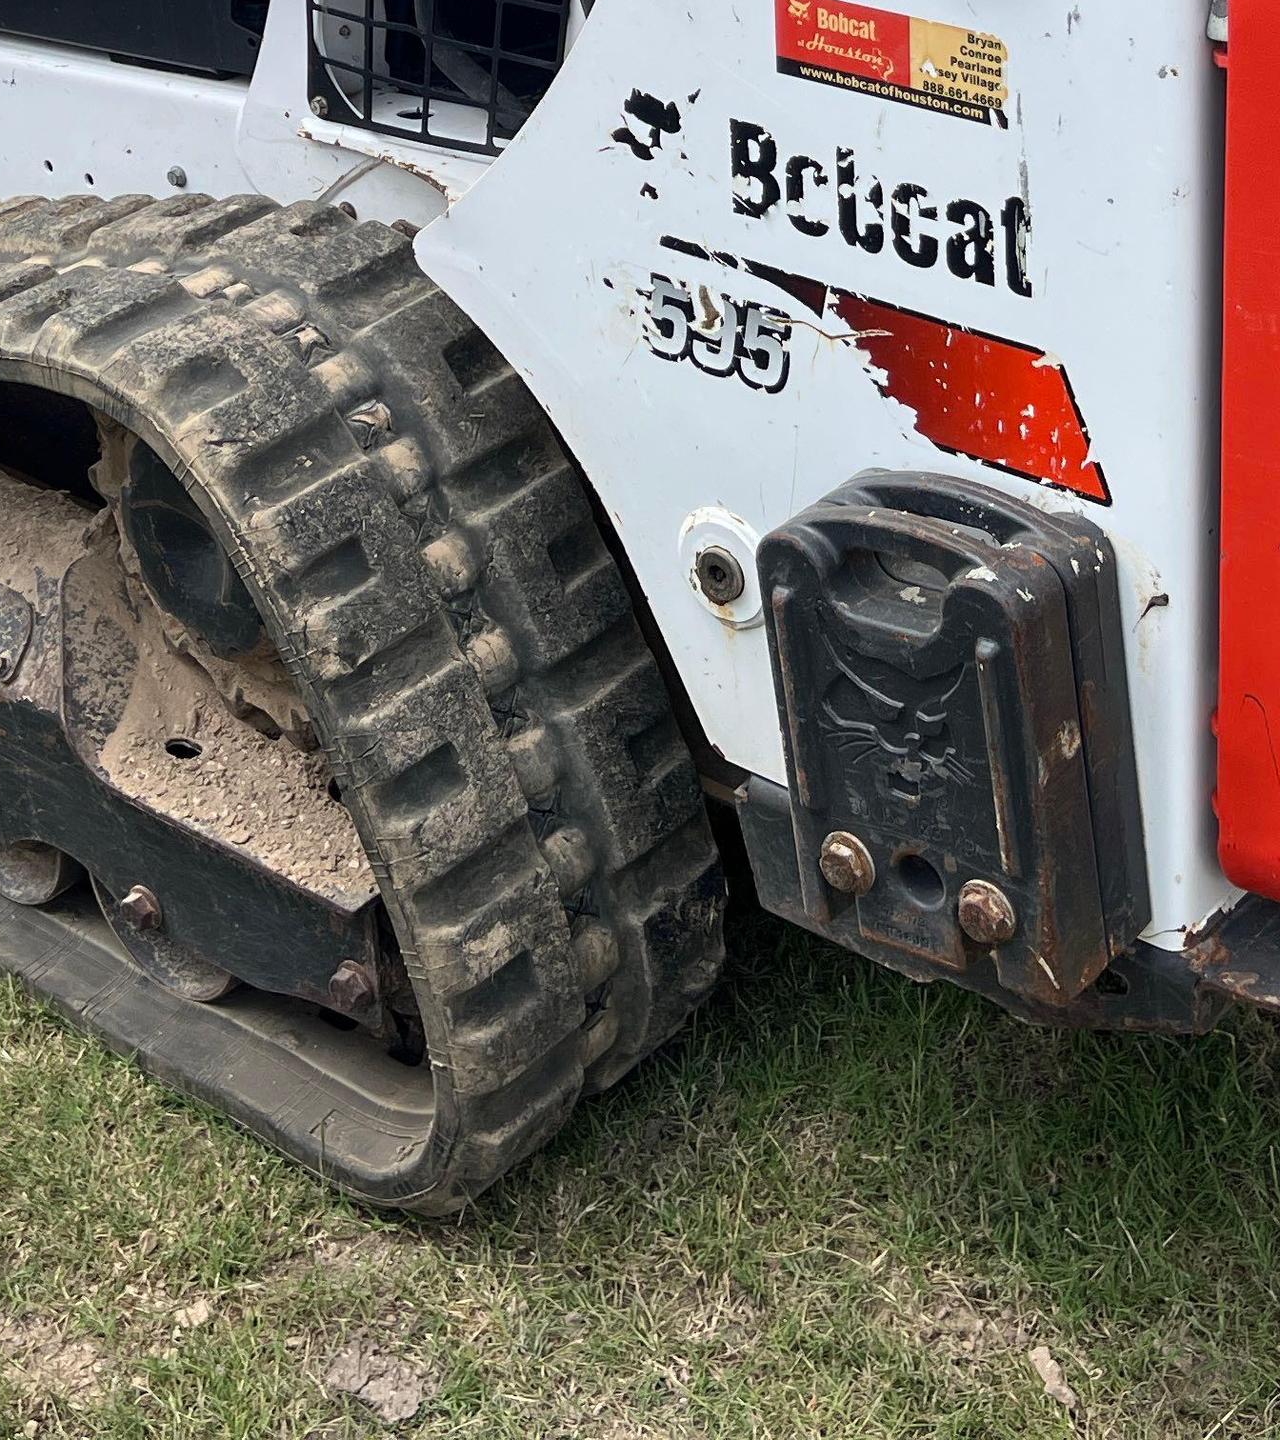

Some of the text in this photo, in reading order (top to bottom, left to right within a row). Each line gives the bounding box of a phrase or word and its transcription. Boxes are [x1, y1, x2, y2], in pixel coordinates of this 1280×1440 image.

[817, 6, 878, 42] Bobcat
[960, 45, 1002, 64] Conroe
[967, 33, 1002, 51] Bryan
[949, 56, 1002, 78] Pearland
[799, 65, 984, 120] www.bobcatofhouston.com
[922, 80, 1003, 110] 888.661.4669
